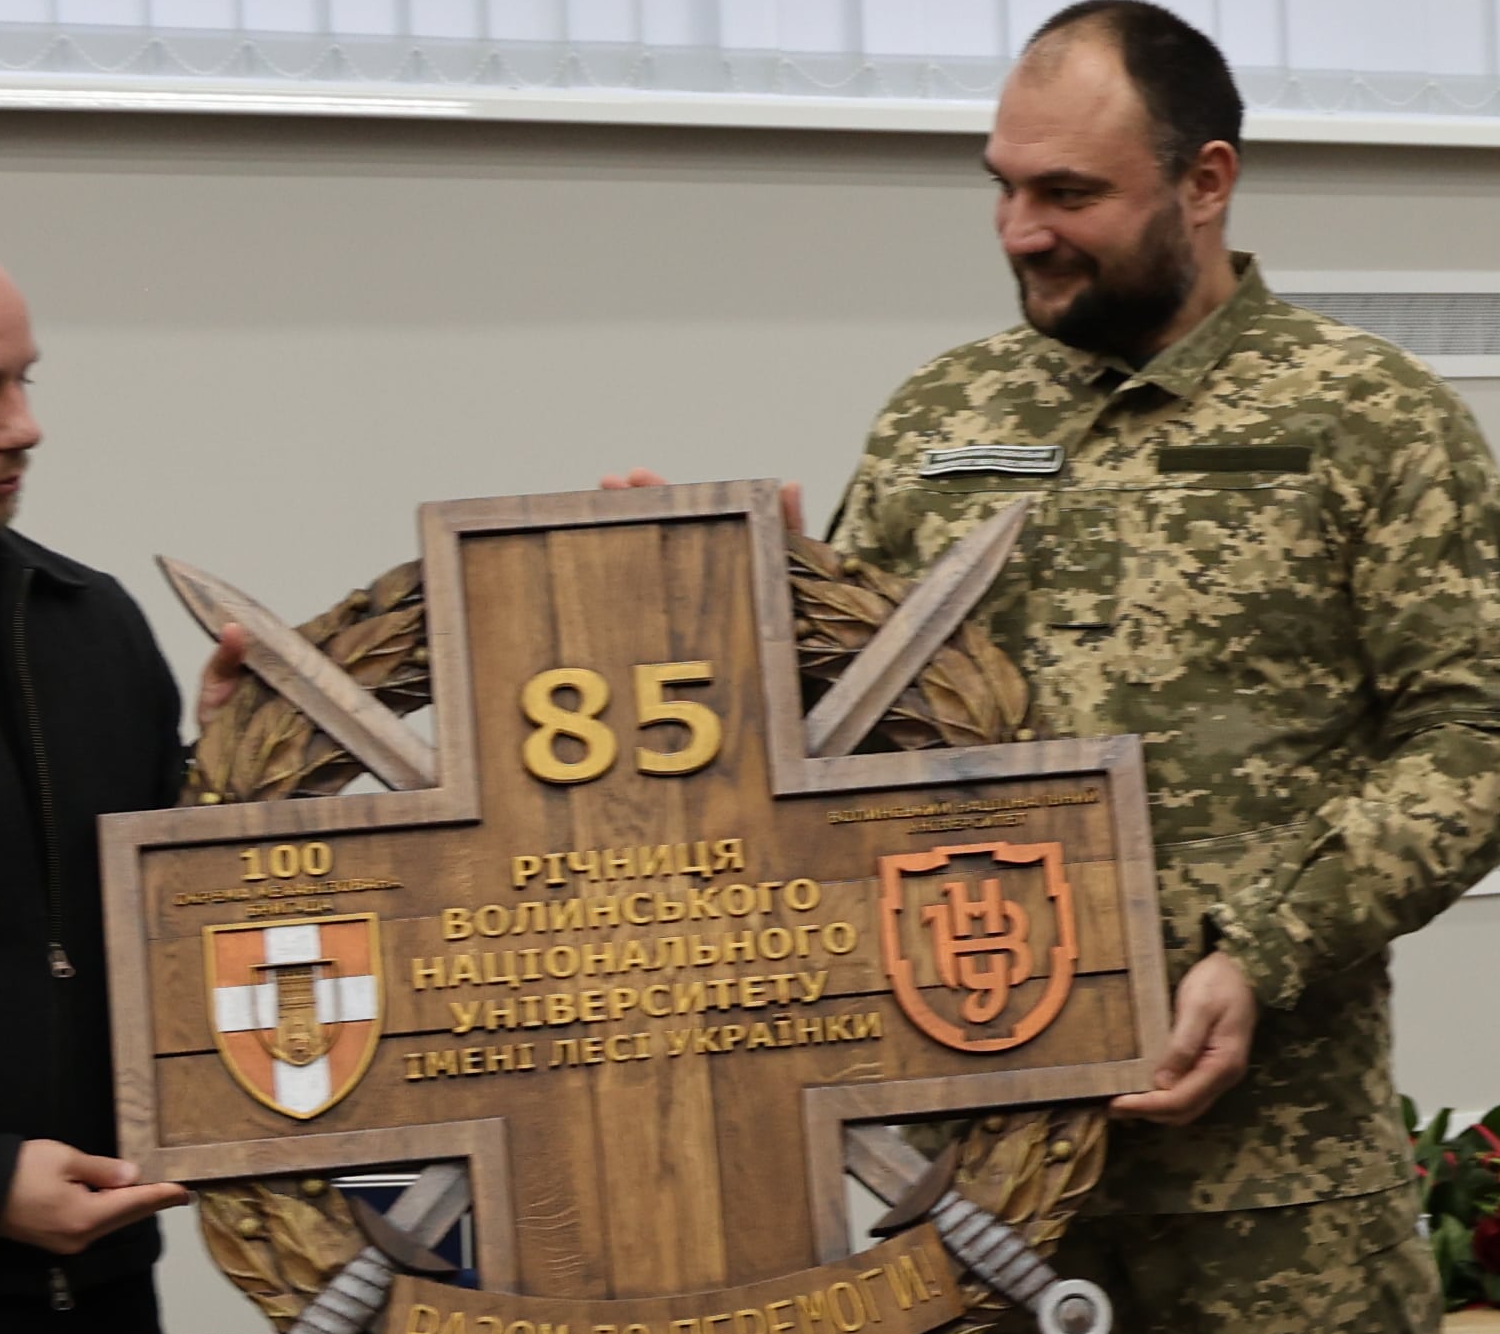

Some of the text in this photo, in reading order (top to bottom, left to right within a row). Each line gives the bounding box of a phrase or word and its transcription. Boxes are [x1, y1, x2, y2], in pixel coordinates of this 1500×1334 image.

[521, 661, 721, 784] 85
[239, 841, 333, 882] 100
[512, 838, 745, 889] РІЧНИЦЯ
[443, 878, 822, 940] ВОЛИНСЬКОГО
[412, 922, 858, 991] НАЦІОНАЛЬНОГО
[449, 971, 829, 1035] УНІВЕРСИТЕТУ
[404, 1012, 884, 1081] ІМЕНІ ЛЕСІ УКРАЇНКИ
